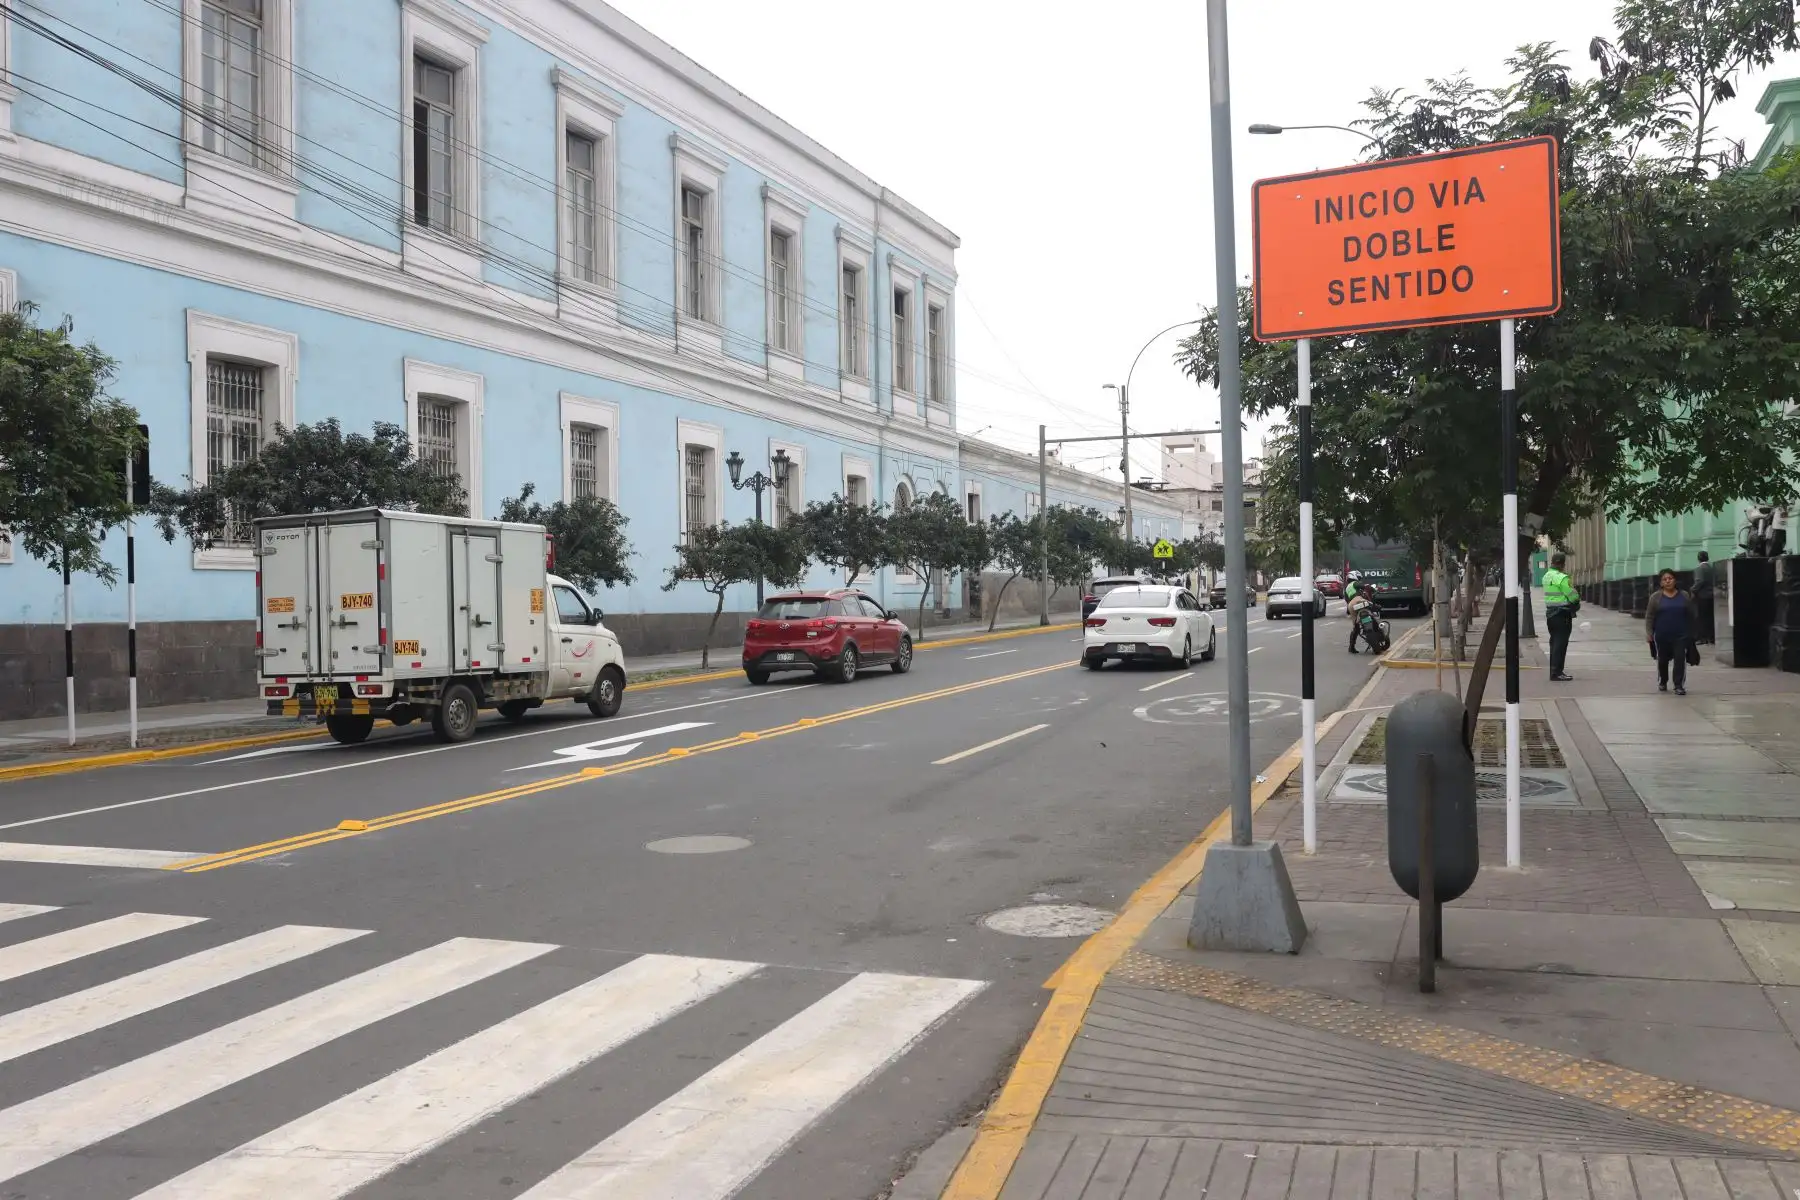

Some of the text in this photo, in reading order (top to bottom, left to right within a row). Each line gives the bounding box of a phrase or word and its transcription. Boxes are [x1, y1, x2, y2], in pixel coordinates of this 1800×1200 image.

[1315, 176, 1486, 225] INICIO VIA
[1344, 223, 1456, 263] DOBLE
[1328, 264, 1474, 306] SENTIDO
[342, 594, 373, 609] BJY-740
[394, 641, 419, 654] BJY-740
